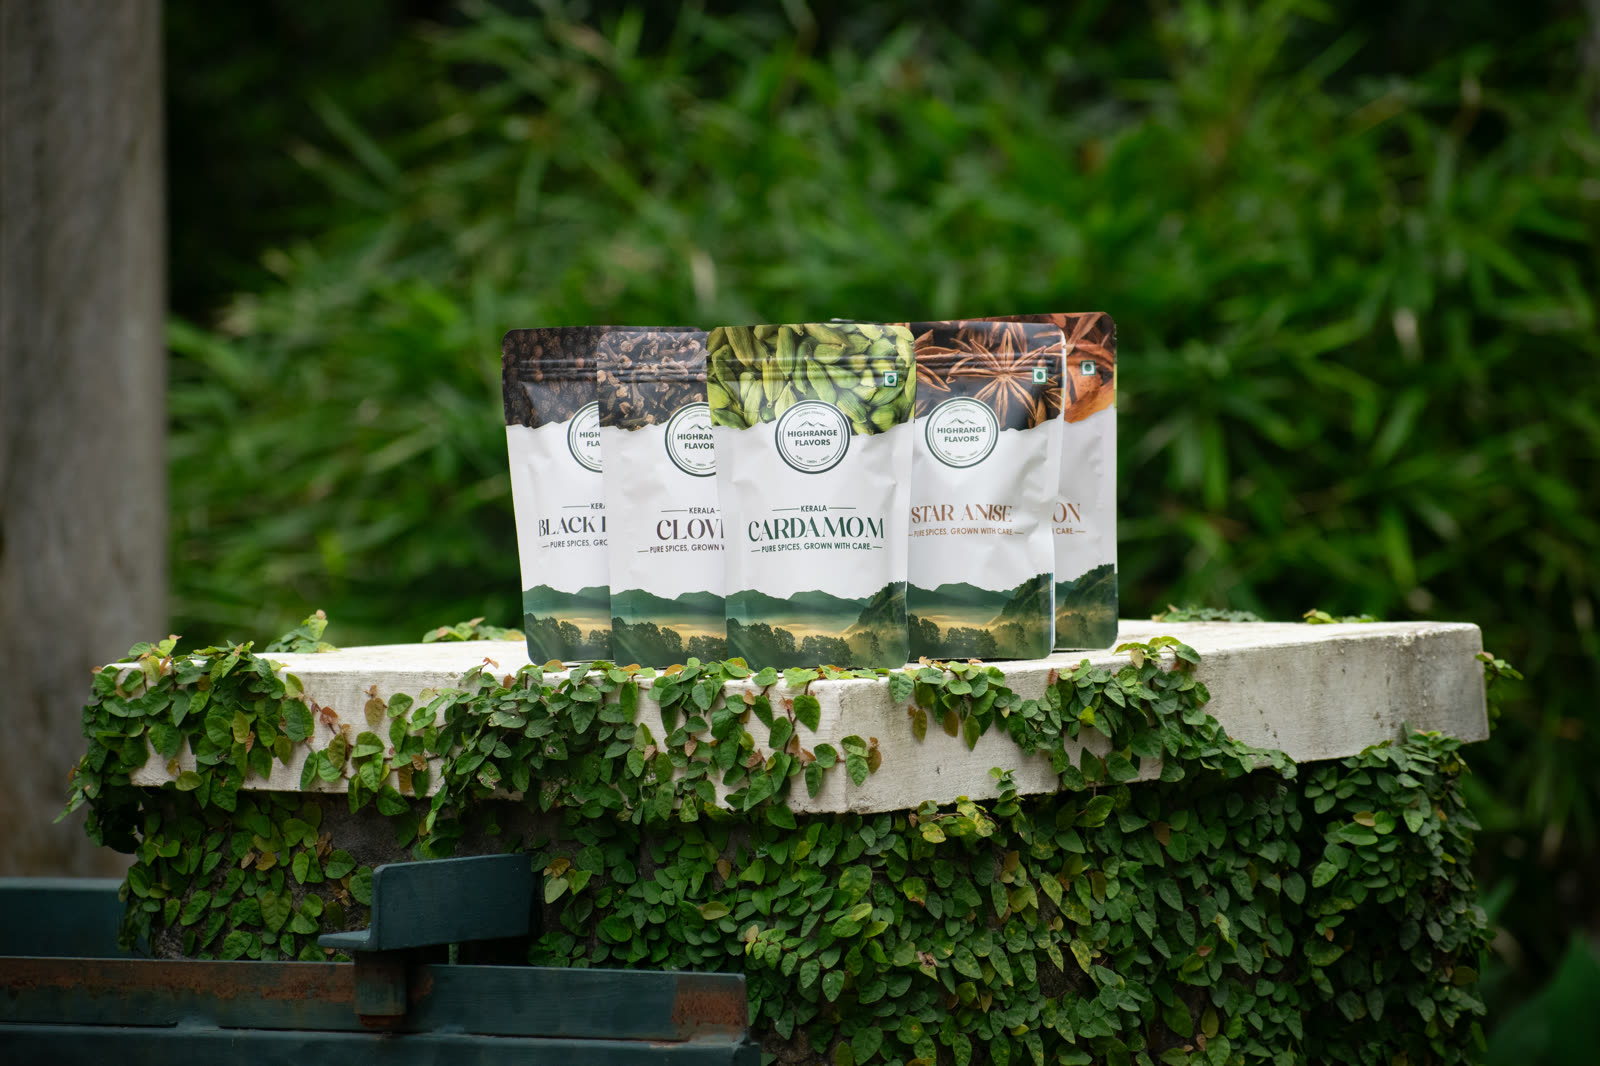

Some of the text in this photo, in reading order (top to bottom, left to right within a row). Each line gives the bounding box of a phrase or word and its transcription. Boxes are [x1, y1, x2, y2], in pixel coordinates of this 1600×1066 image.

[911, 503, 1012, 524] STAR ANISE
[538, 516, 596, 536] BLACK
[748, 516, 884, 542] CARDAMOM
